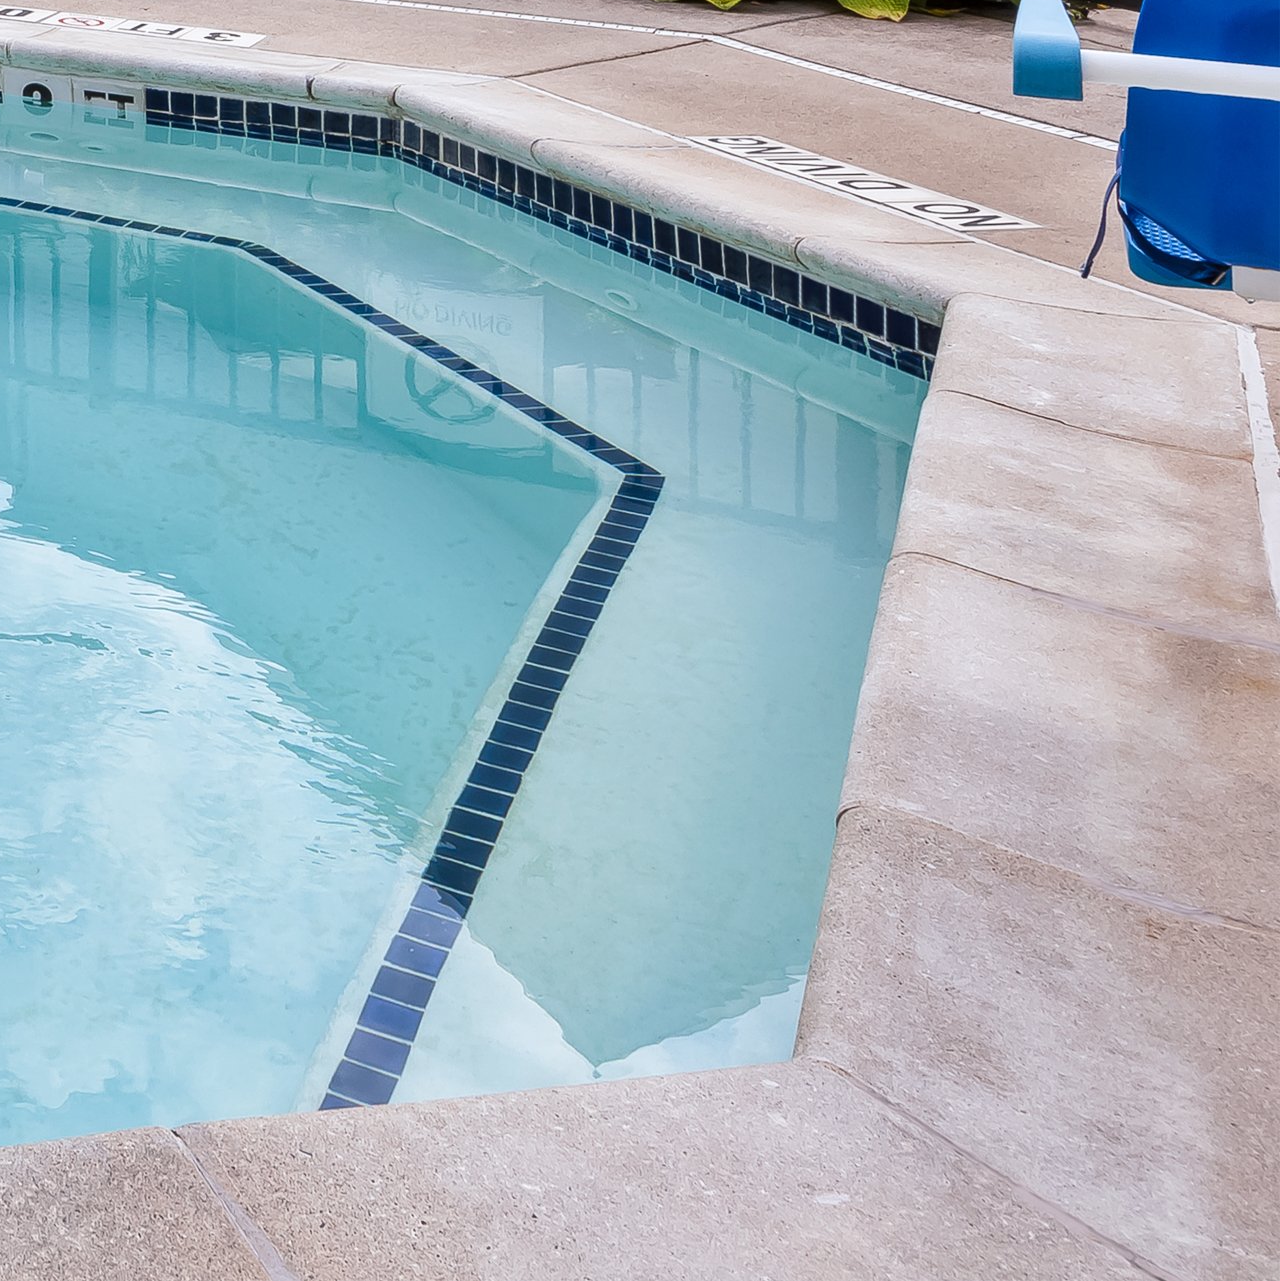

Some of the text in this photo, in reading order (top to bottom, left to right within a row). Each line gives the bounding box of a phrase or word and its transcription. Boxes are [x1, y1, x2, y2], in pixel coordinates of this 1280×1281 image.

[128, 23, 187, 37] FT
[203, 31, 242, 43] 3
[708, 136, 1024, 228] NO DIVING
